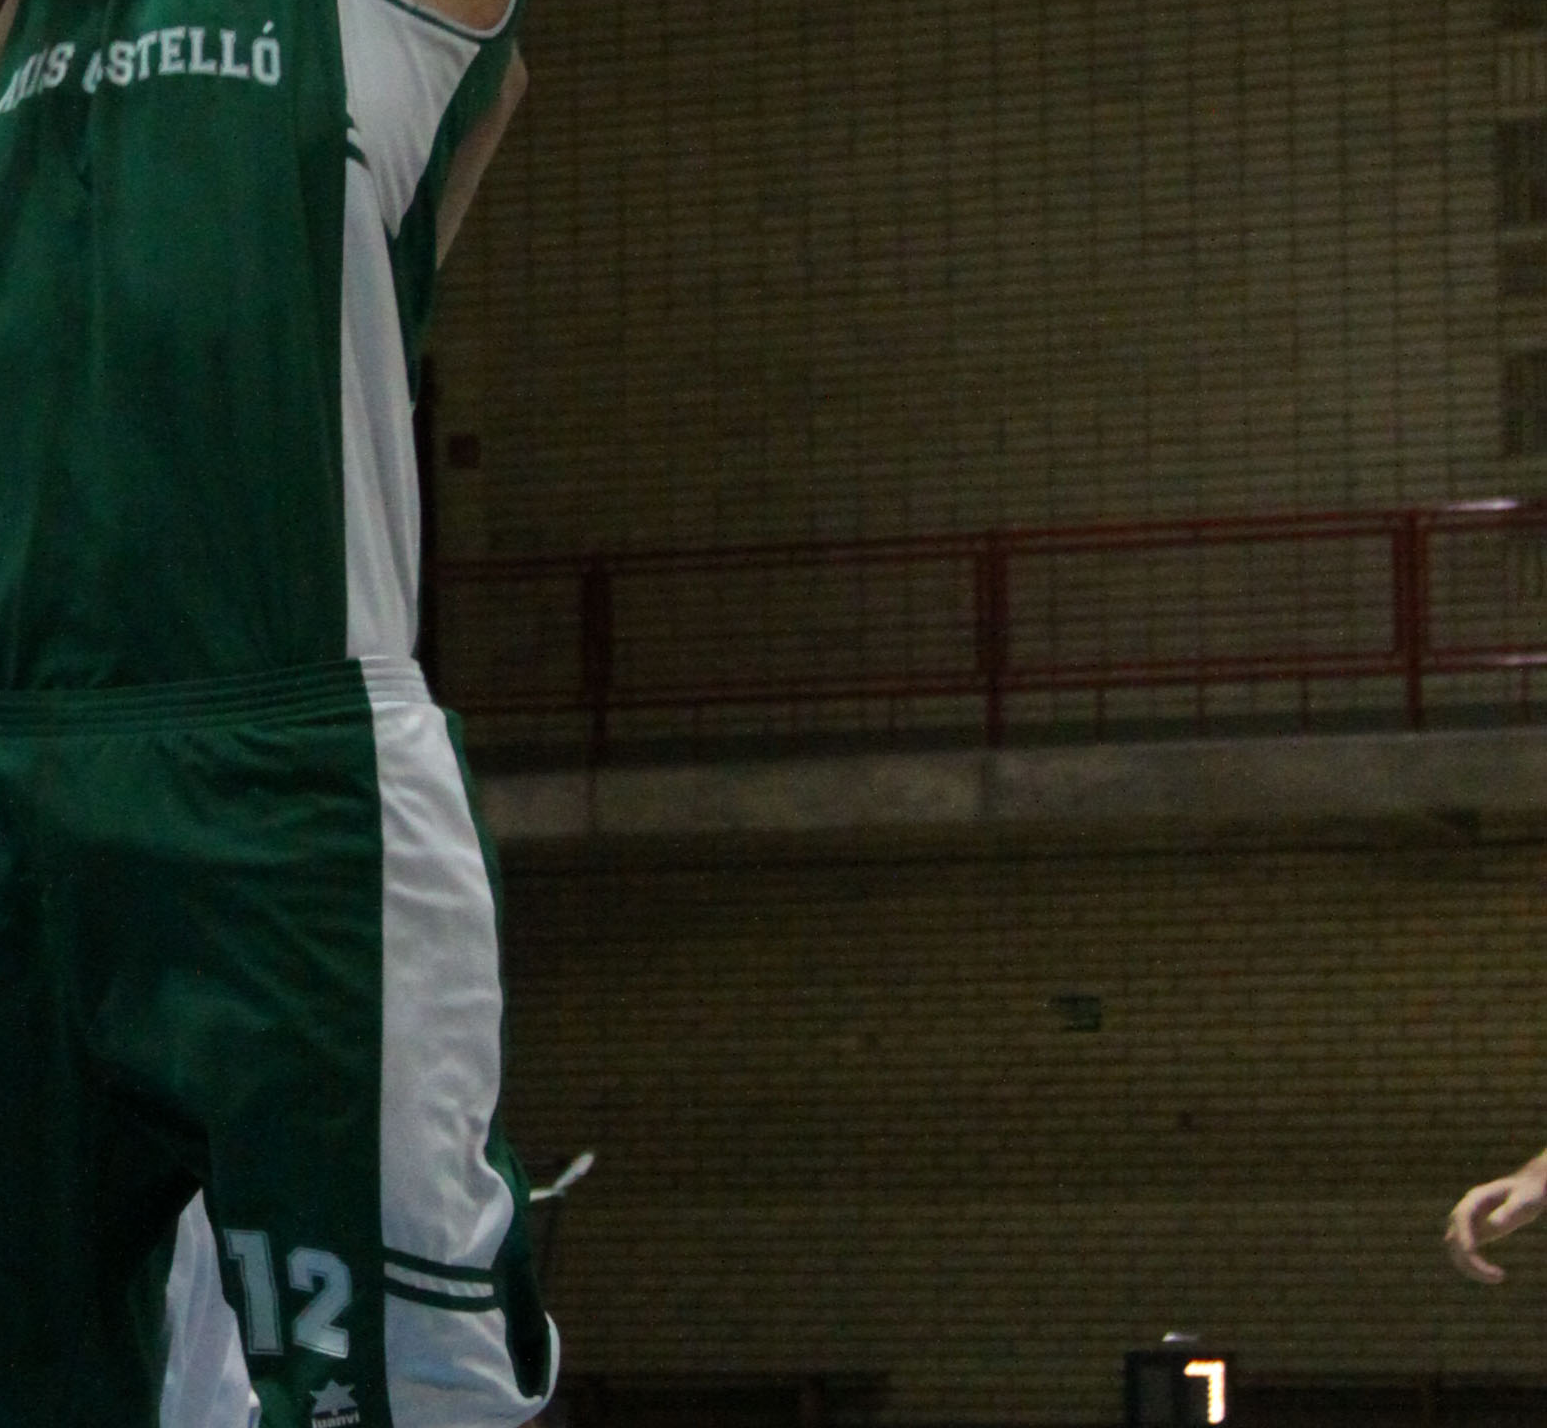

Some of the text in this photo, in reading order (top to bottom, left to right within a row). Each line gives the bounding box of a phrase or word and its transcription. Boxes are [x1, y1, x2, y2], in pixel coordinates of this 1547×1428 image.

[81, 20, 281, 99] CSTELLÓ
[222, 1228, 352, 1359] 12
[1184, 1359, 1226, 1425] 7
